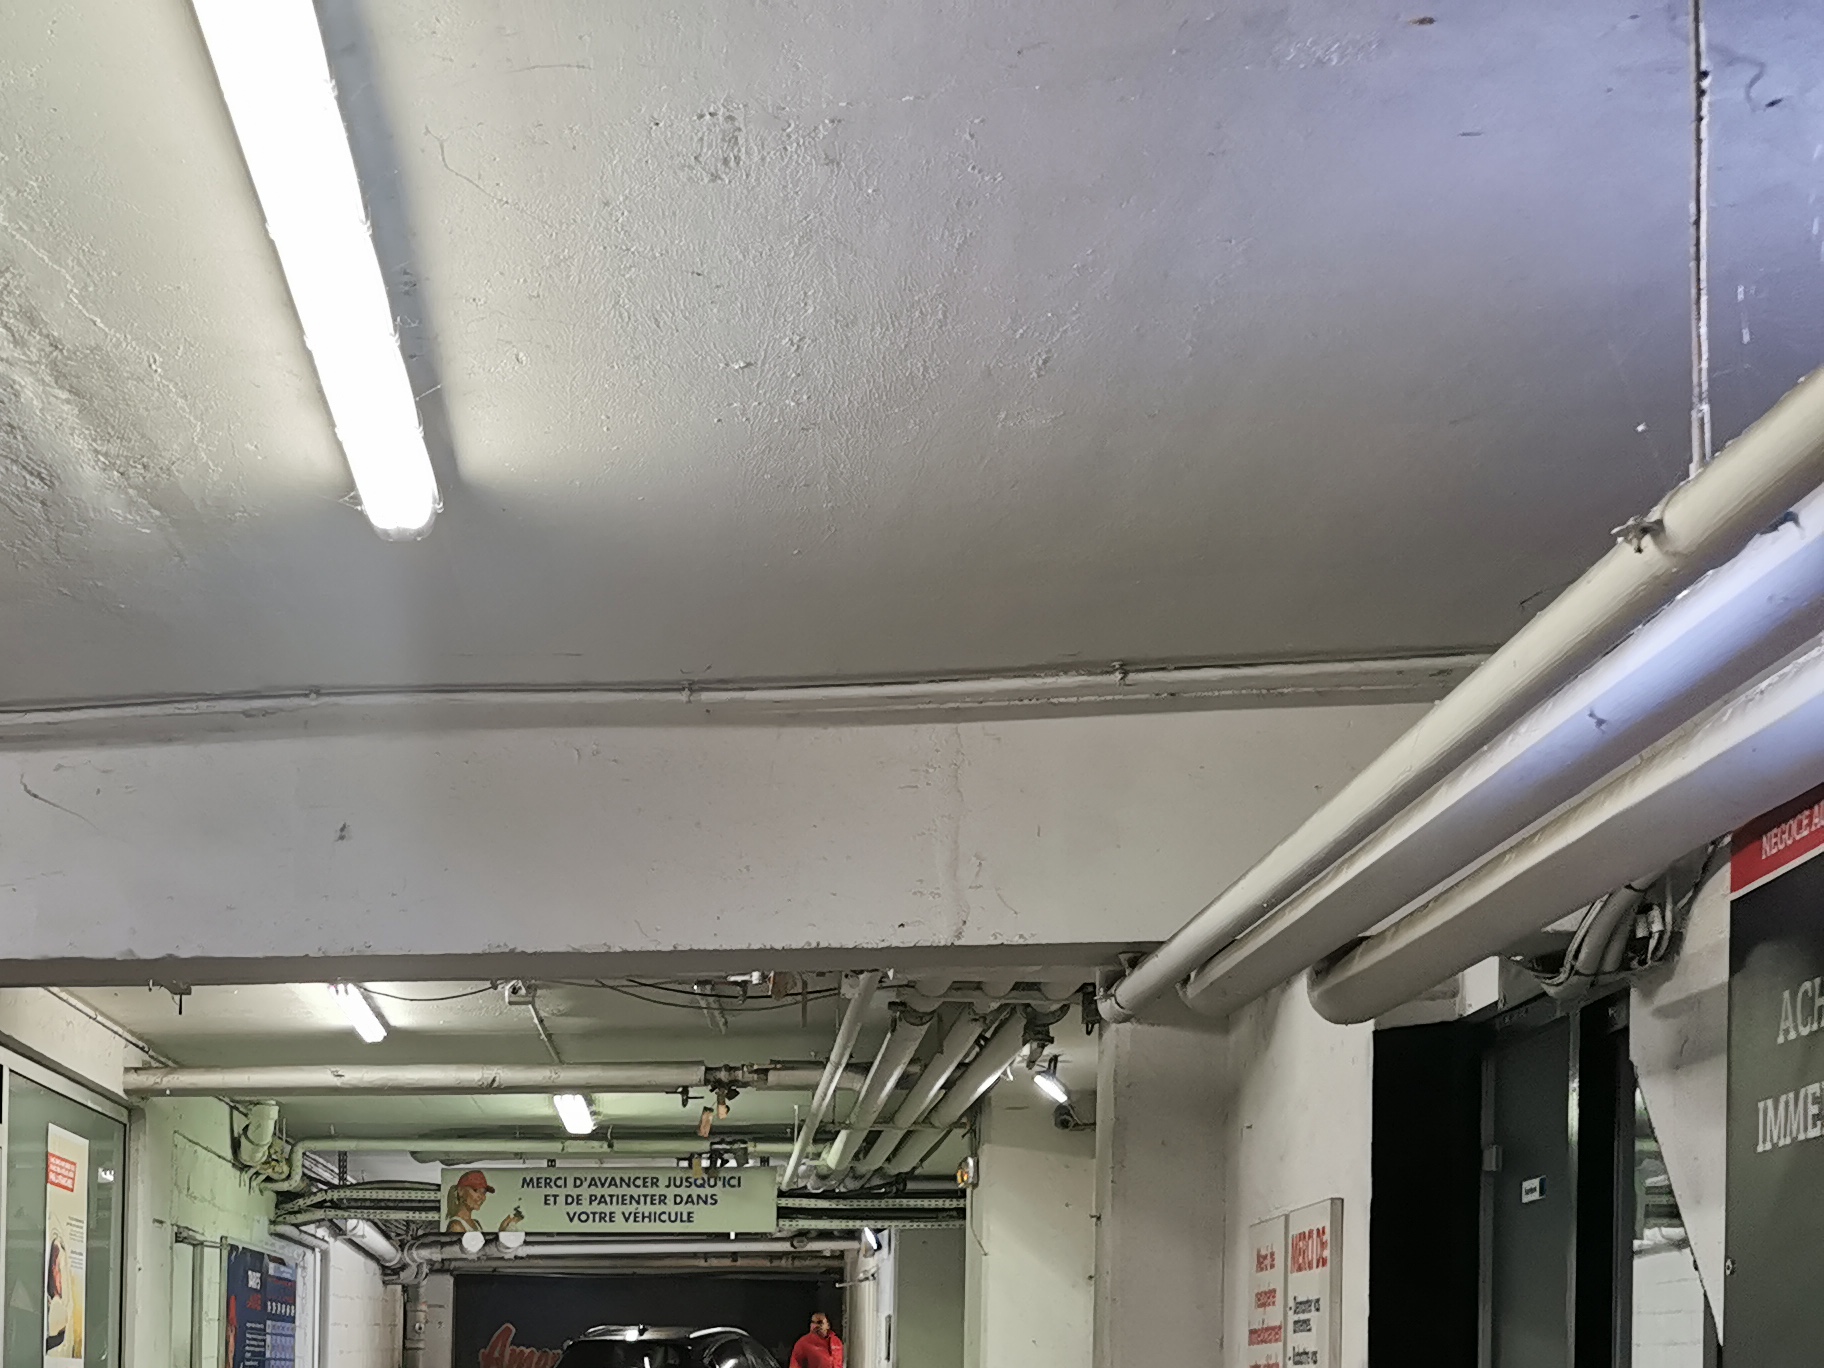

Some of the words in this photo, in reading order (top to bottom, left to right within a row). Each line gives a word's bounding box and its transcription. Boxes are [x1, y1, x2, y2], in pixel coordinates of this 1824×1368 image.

[1761, 809, 1810, 860] NEGOCE
[1756, 1081, 1824, 1153] IMME
[521, 1176, 567, 1189] MERCI
[572, 1176, 659, 1189] D'AVANCER
[665, 1176, 742, 1190] JUSQU'ICI
[543, 1193, 559, 1206] ET
[564, 1193, 584, 1206] DE
[588, 1193, 668, 1206] PATIENTER
[673, 1193, 719, 1206] DANS
[566, 1210, 616, 1223] VOTRE
[622, 1207, 695, 1223] VÉHICULE
